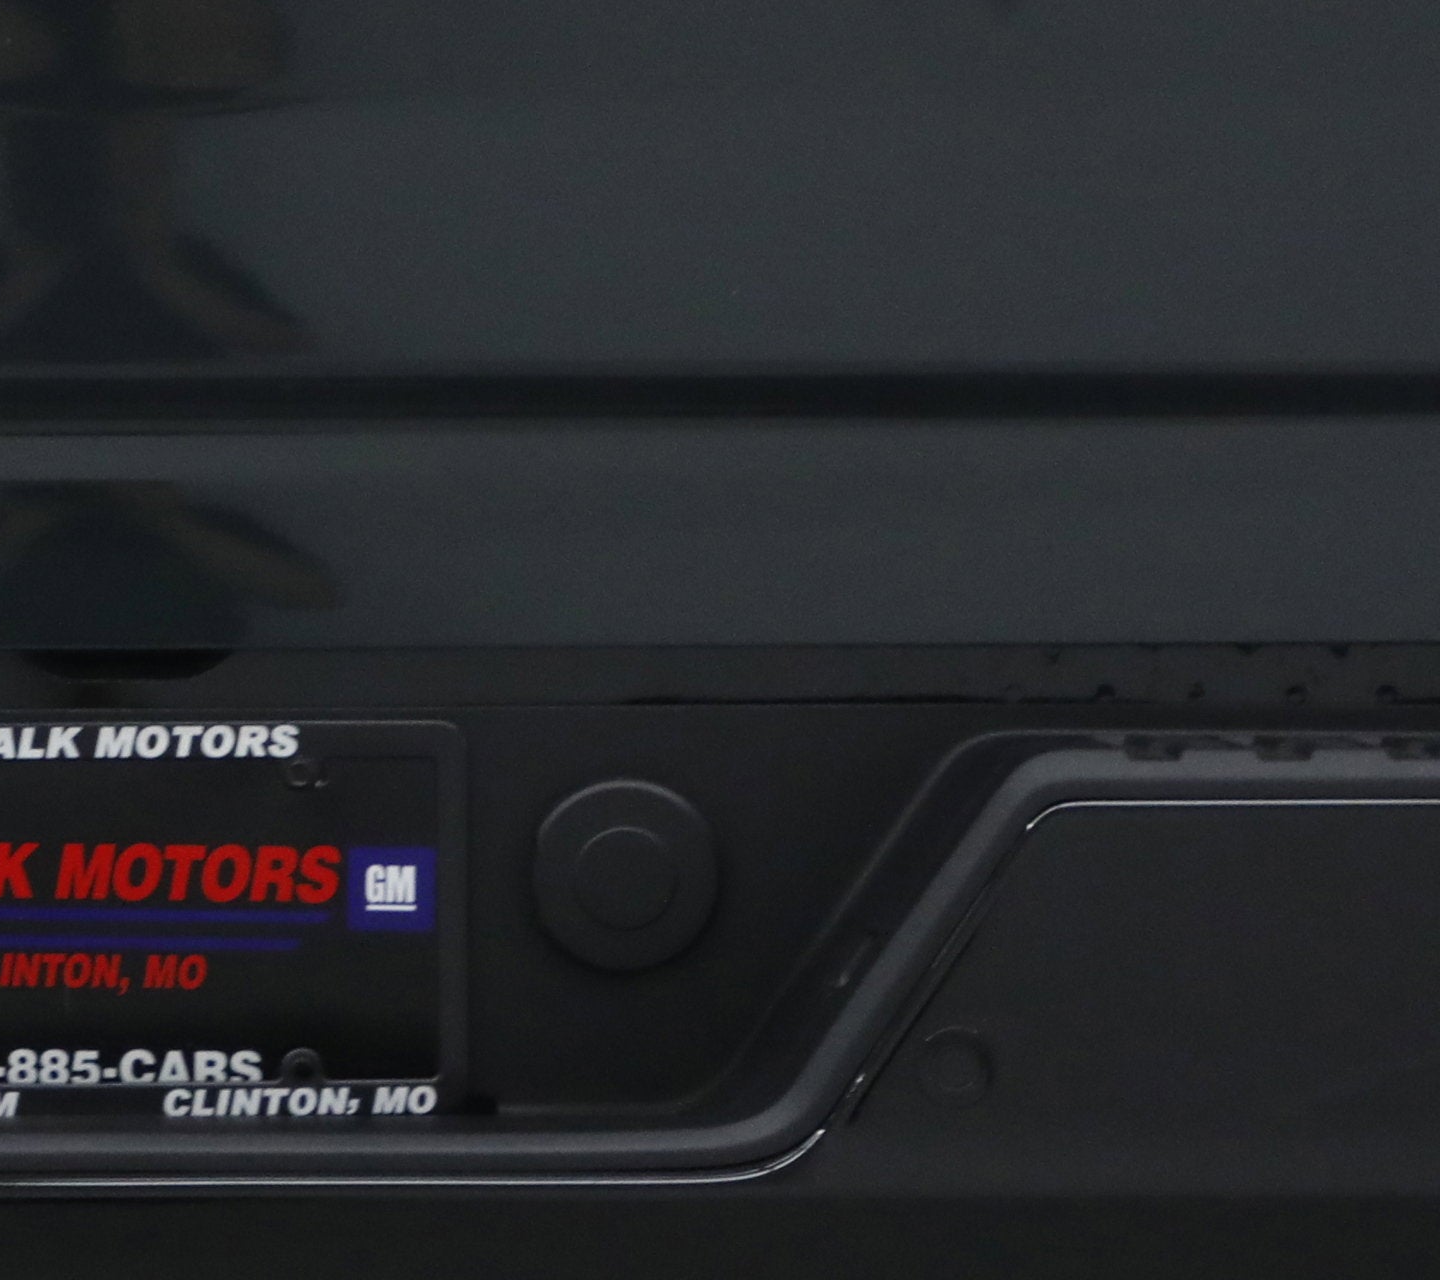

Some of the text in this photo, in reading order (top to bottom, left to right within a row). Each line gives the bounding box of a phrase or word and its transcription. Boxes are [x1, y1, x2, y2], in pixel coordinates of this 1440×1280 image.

[94, 724, 300, 759] MOTORS
[55, 843, 342, 904] MOTORS
[364, 864, 417, 903] GM
[143, 954, 208, 990] MO
[162, 1084, 438, 1118] CLINTON, MO
